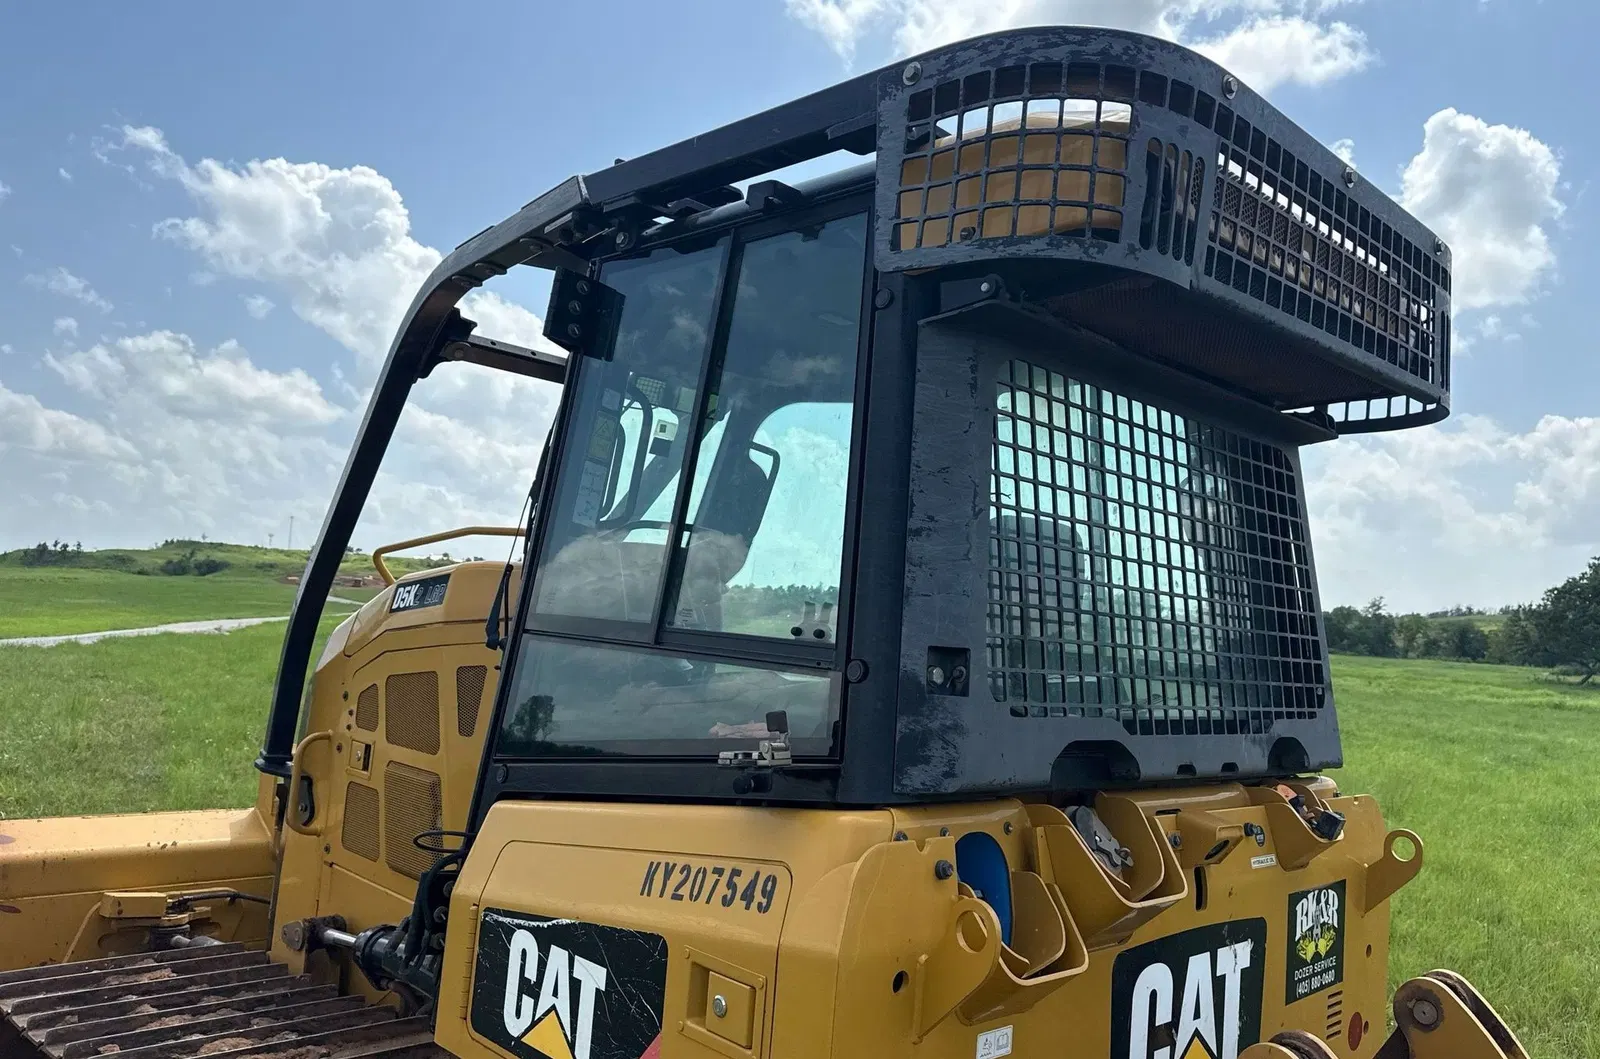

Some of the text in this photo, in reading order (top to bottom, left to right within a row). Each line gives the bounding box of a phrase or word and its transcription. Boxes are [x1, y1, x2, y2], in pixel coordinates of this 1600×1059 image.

[640, 861, 777, 914] KY207549
[503, 929, 607, 1059] CAT
[1294, 956, 1337, 981] DOZER SERVICE
[1296, 980, 1310, 998] (405)
[1129, 938, 1254, 1059] CAT
